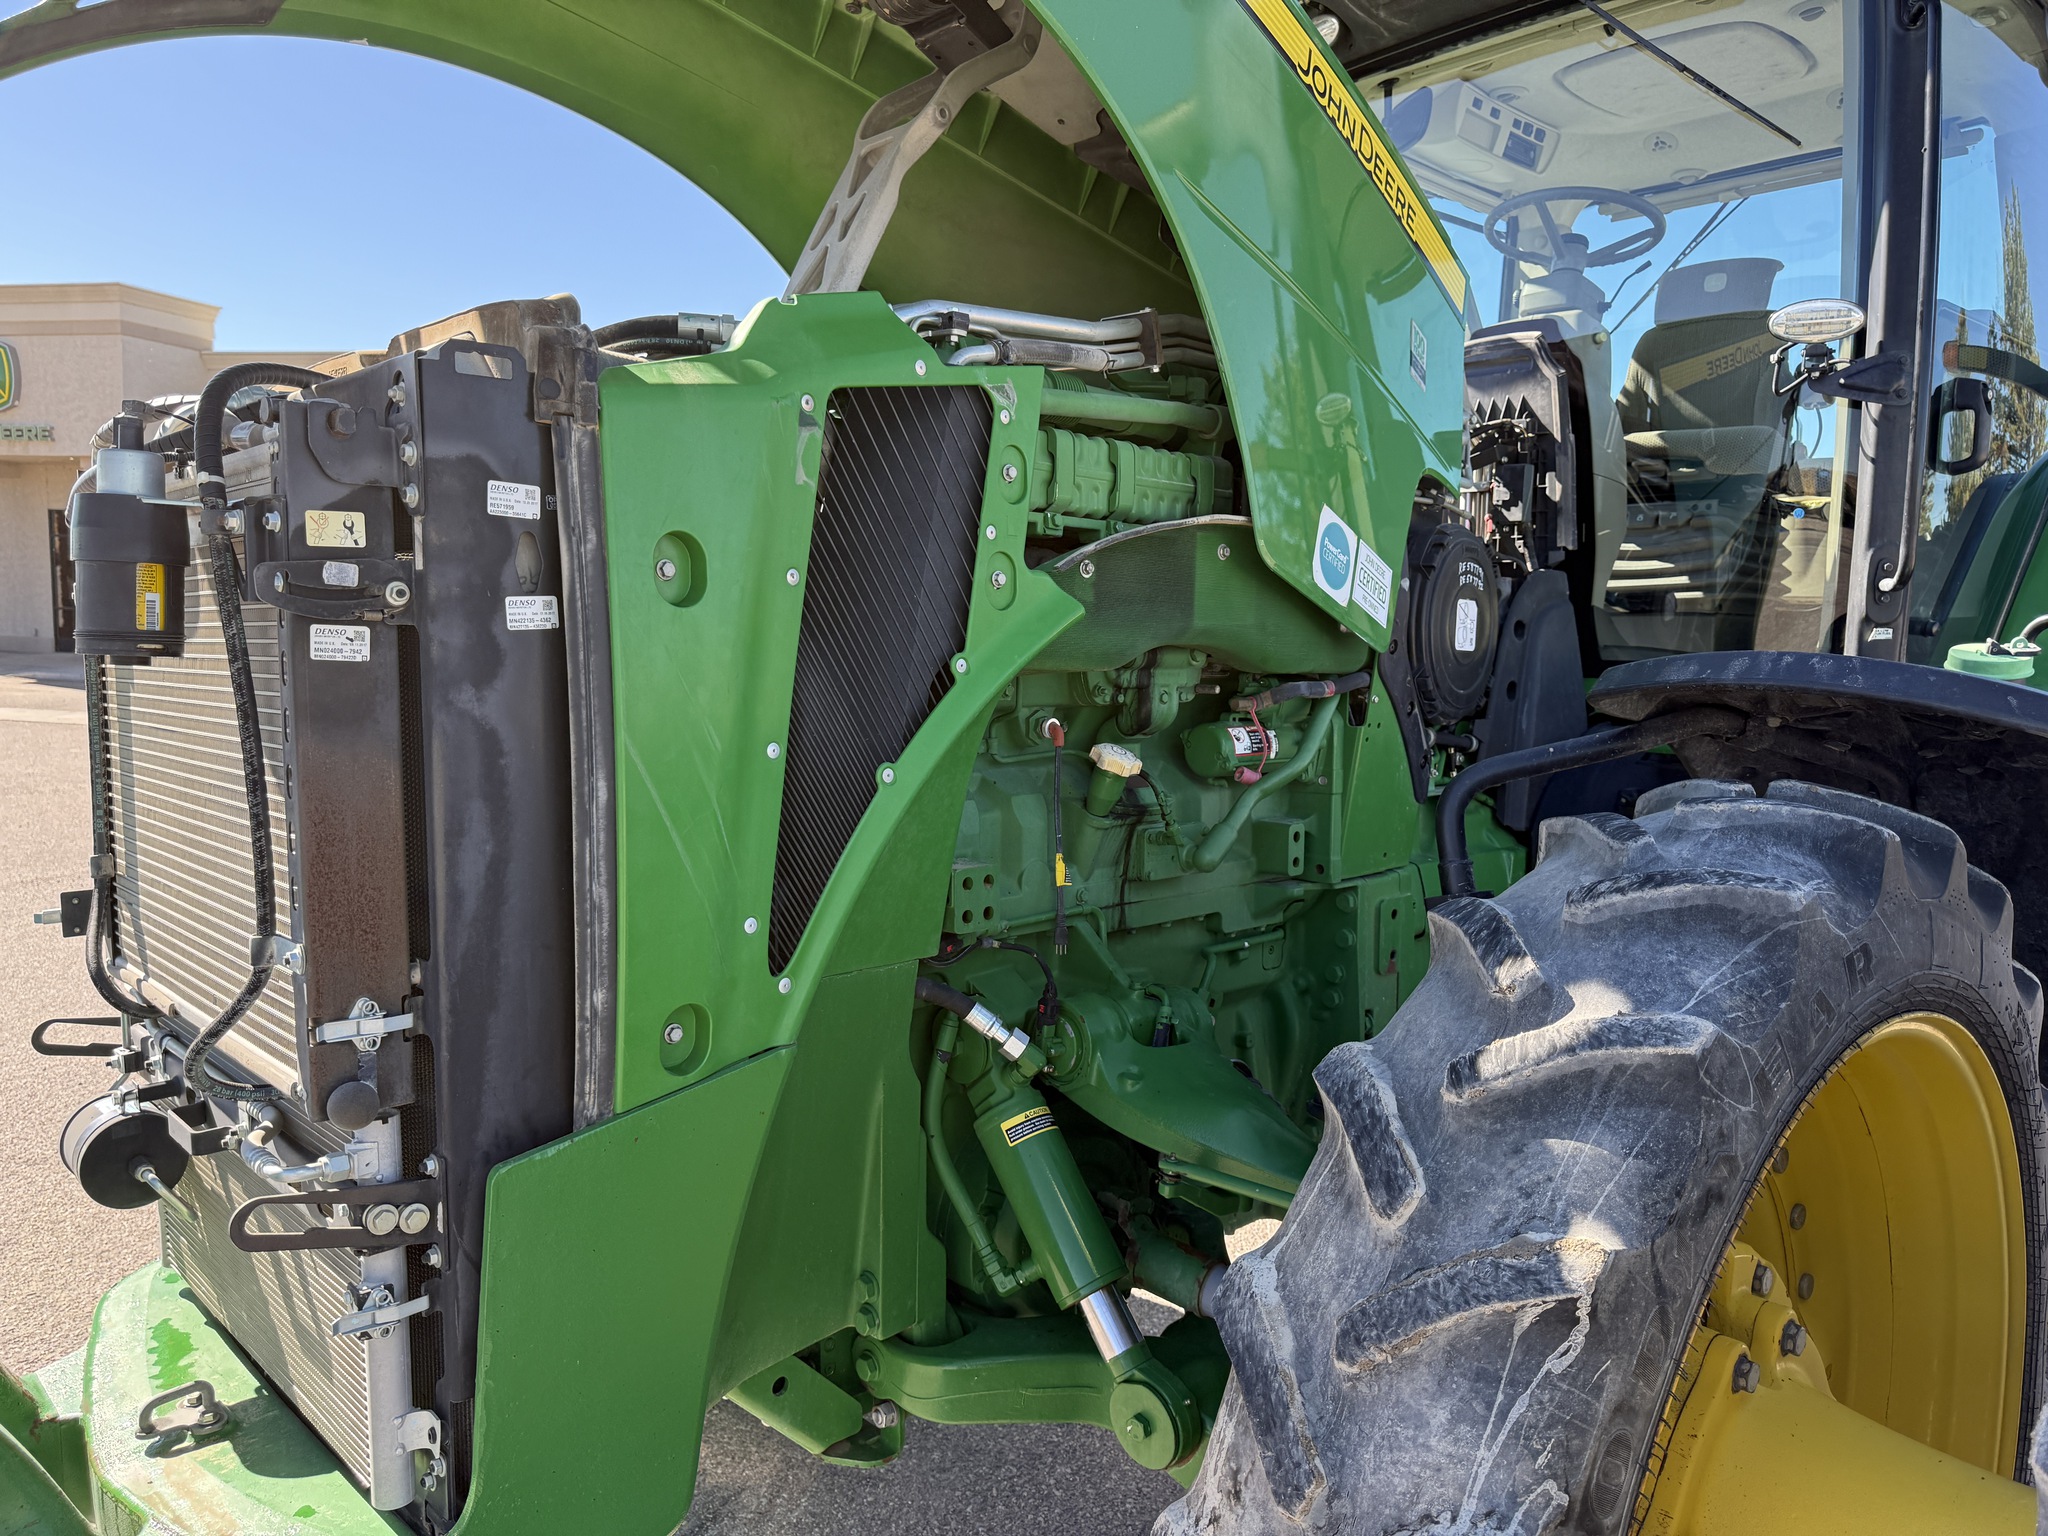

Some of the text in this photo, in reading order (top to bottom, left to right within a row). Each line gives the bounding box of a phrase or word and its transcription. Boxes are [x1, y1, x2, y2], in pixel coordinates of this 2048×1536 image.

[1298, 47, 1417, 235] JOHN DEERE
[0, 424, 50, 441] EERE
[490, 484, 519, 493] DENSO
[1322, 547, 1346, 575] CERTIFIED
[1359, 567, 1387, 605] CERTIFIED
[508, 599, 537, 607] DENSO
[314, 627, 347, 636] DENSO
[212, 1085, 221, 1093] 28
[220, 1087, 233, 1096] bar
[234, 1089, 251, 1098] (400
[1028, 1107, 1049, 1117] CAUTION
